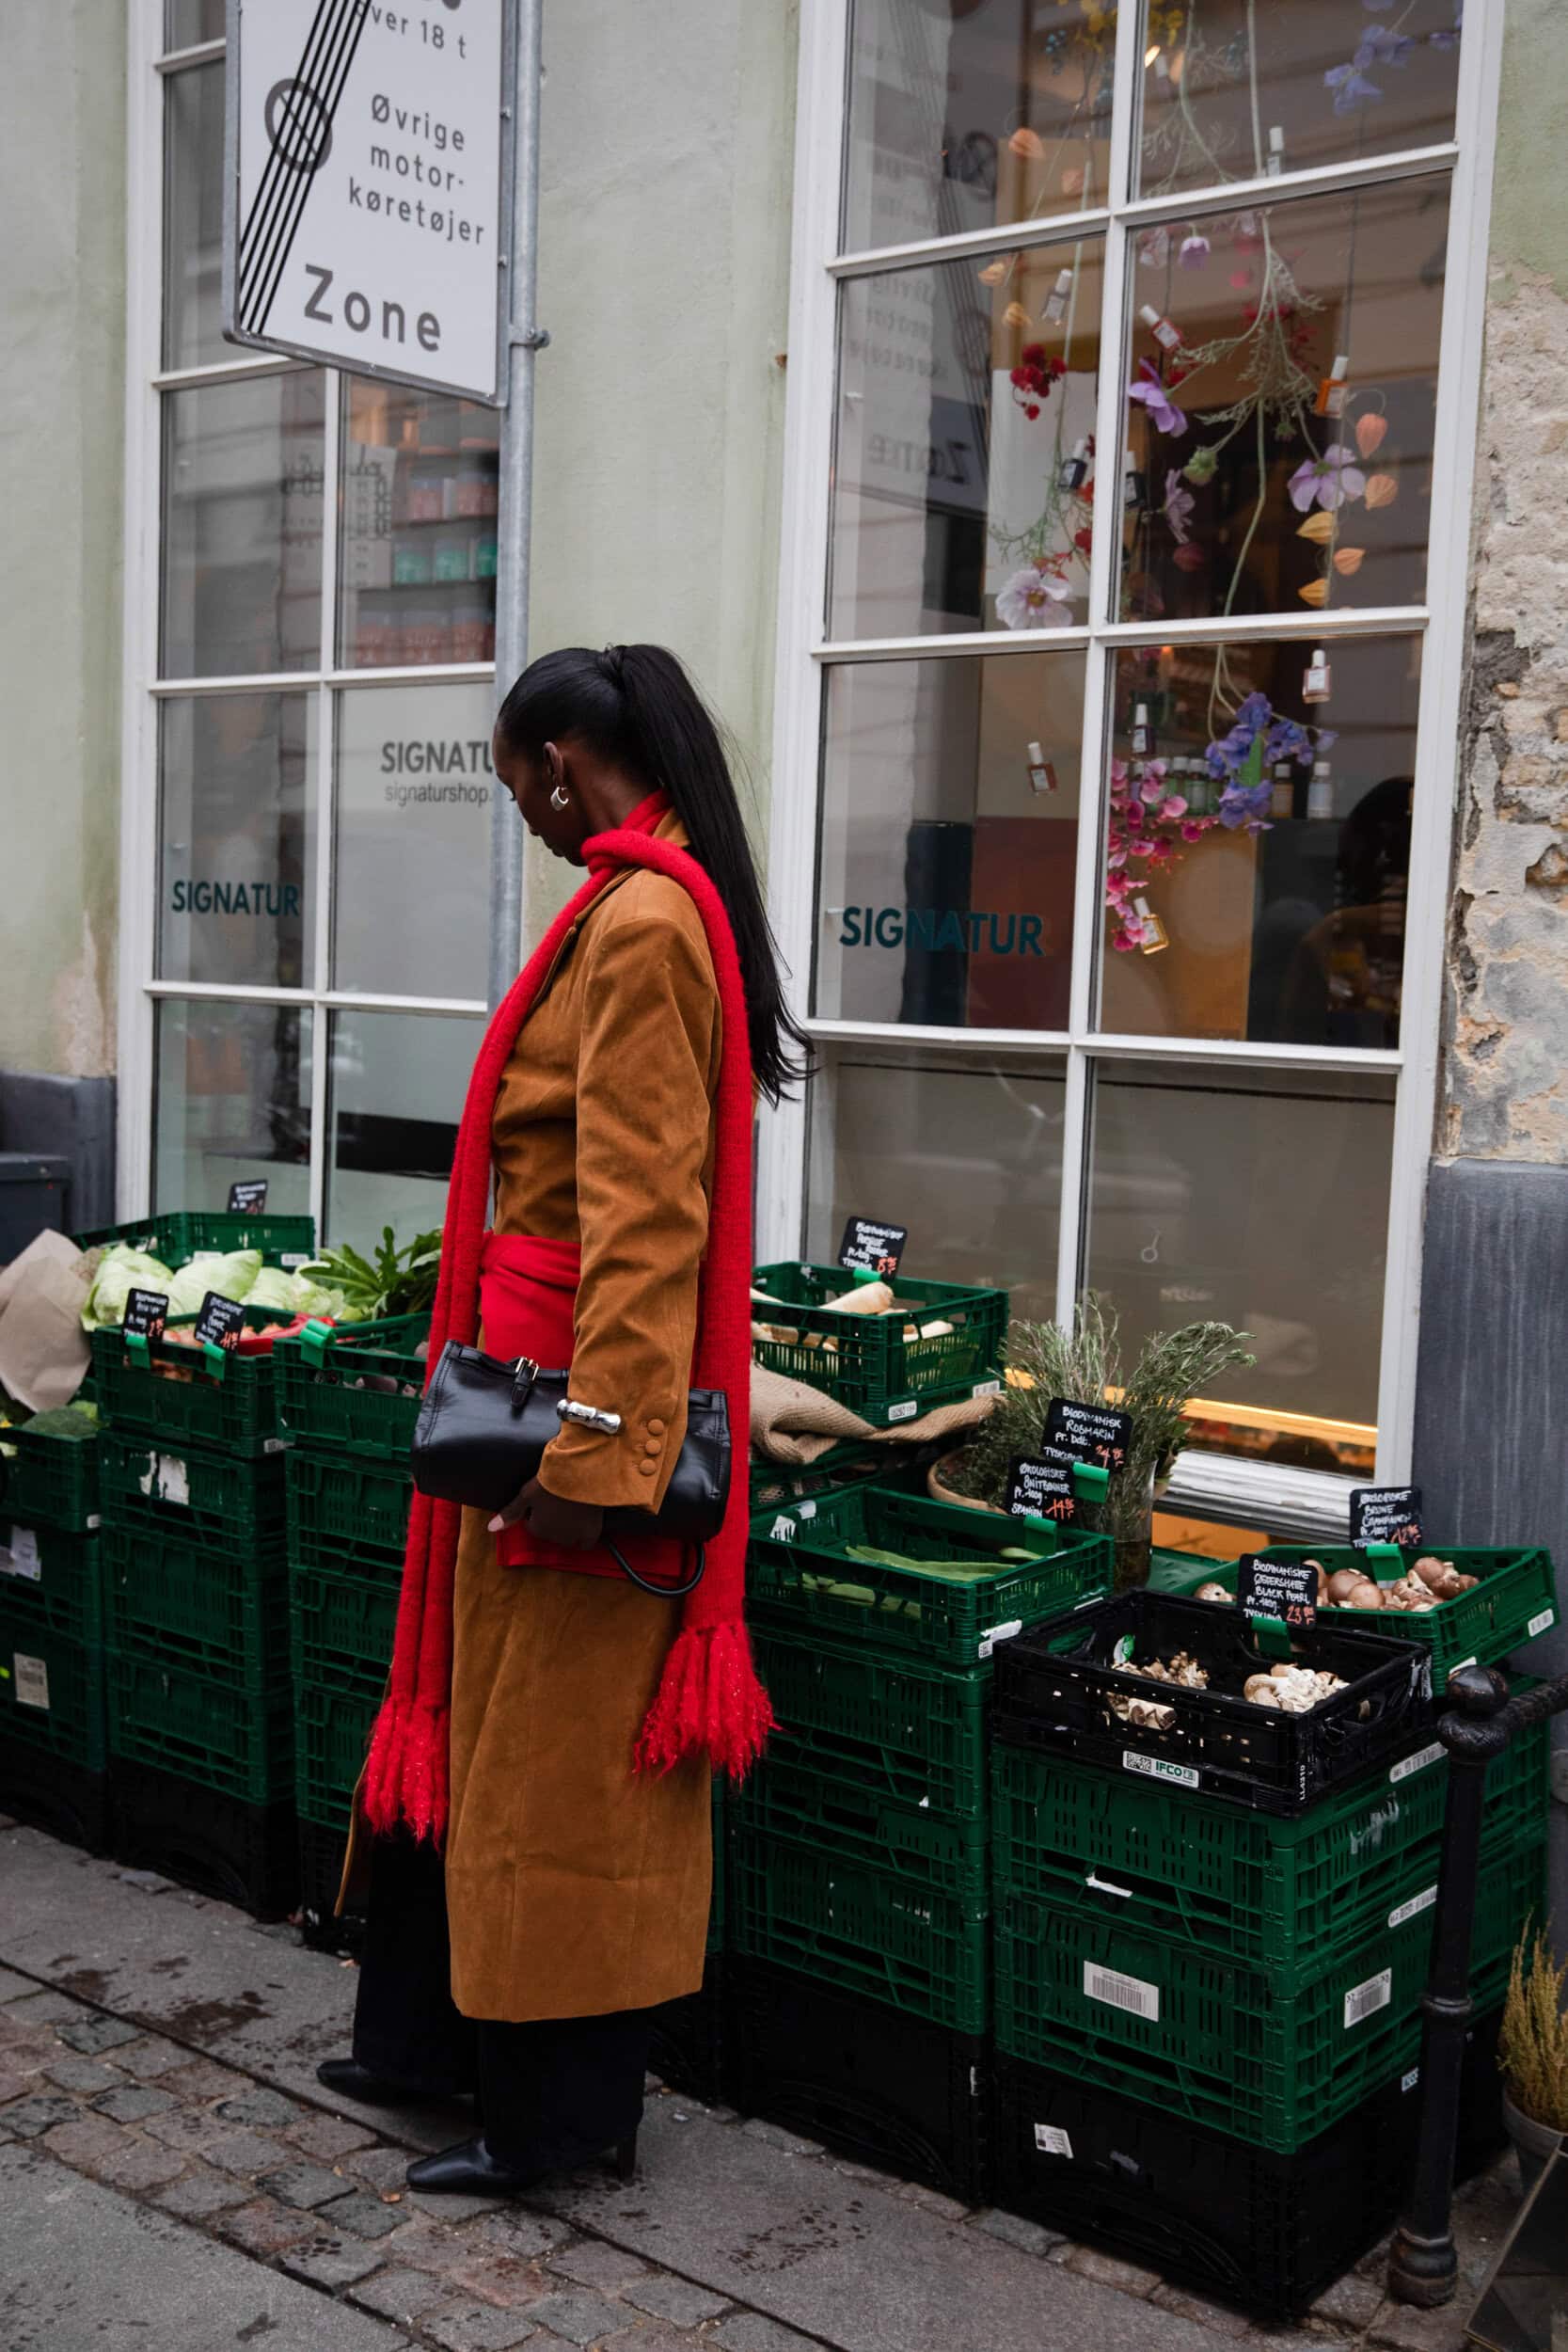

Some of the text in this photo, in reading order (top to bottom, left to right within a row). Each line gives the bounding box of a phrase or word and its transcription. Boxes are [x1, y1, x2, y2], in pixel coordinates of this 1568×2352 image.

[420, 19, 445, 50] 18
[458, 35, 467, 59] t
[371, 93, 466, 151] Øvrige
[370, 145, 465, 192] motor-
[348, 176, 484, 245] køretøjer
[304, 262, 441, 353] Zone
[171, 879, 300, 918] SIGNATUR
[839, 906, 1046, 957] SIGNATUR
[1155, 1760, 1182, 1777] IFCO
